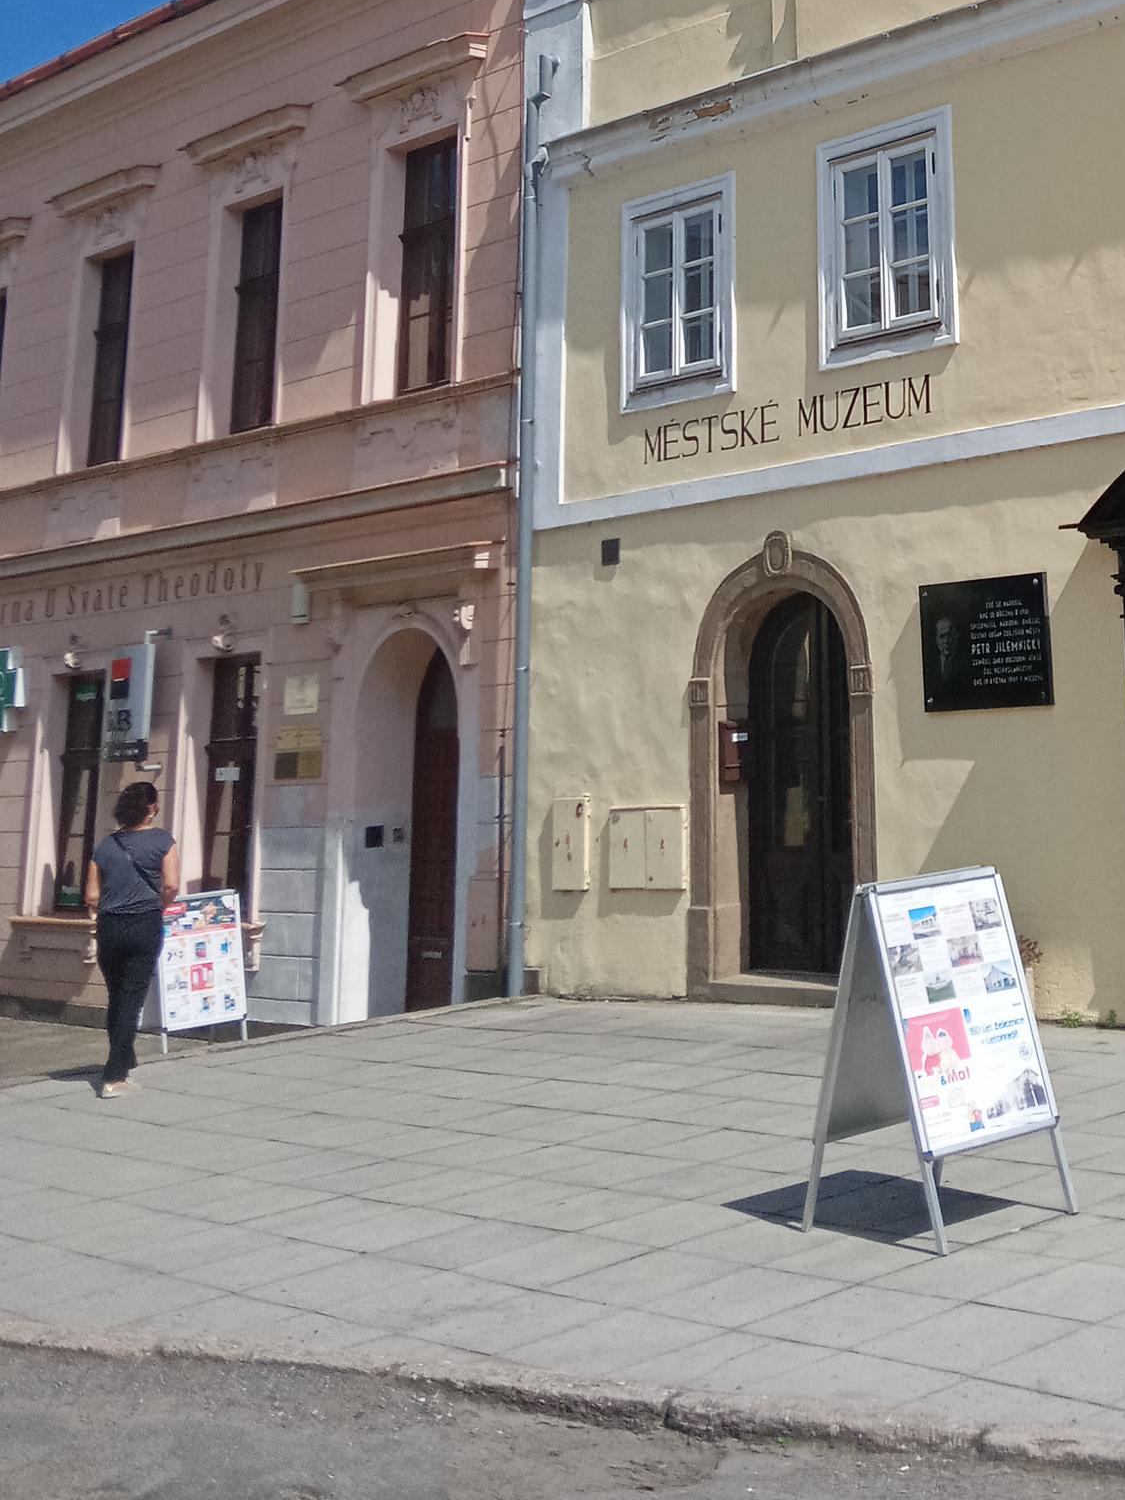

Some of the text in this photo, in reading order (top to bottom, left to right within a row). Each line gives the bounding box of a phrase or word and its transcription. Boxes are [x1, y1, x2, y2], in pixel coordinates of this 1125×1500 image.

[798, 374, 932, 437] MUZEUM
[141, 561, 264, 605] Theodoty
[971, 642, 991, 655] PETR
